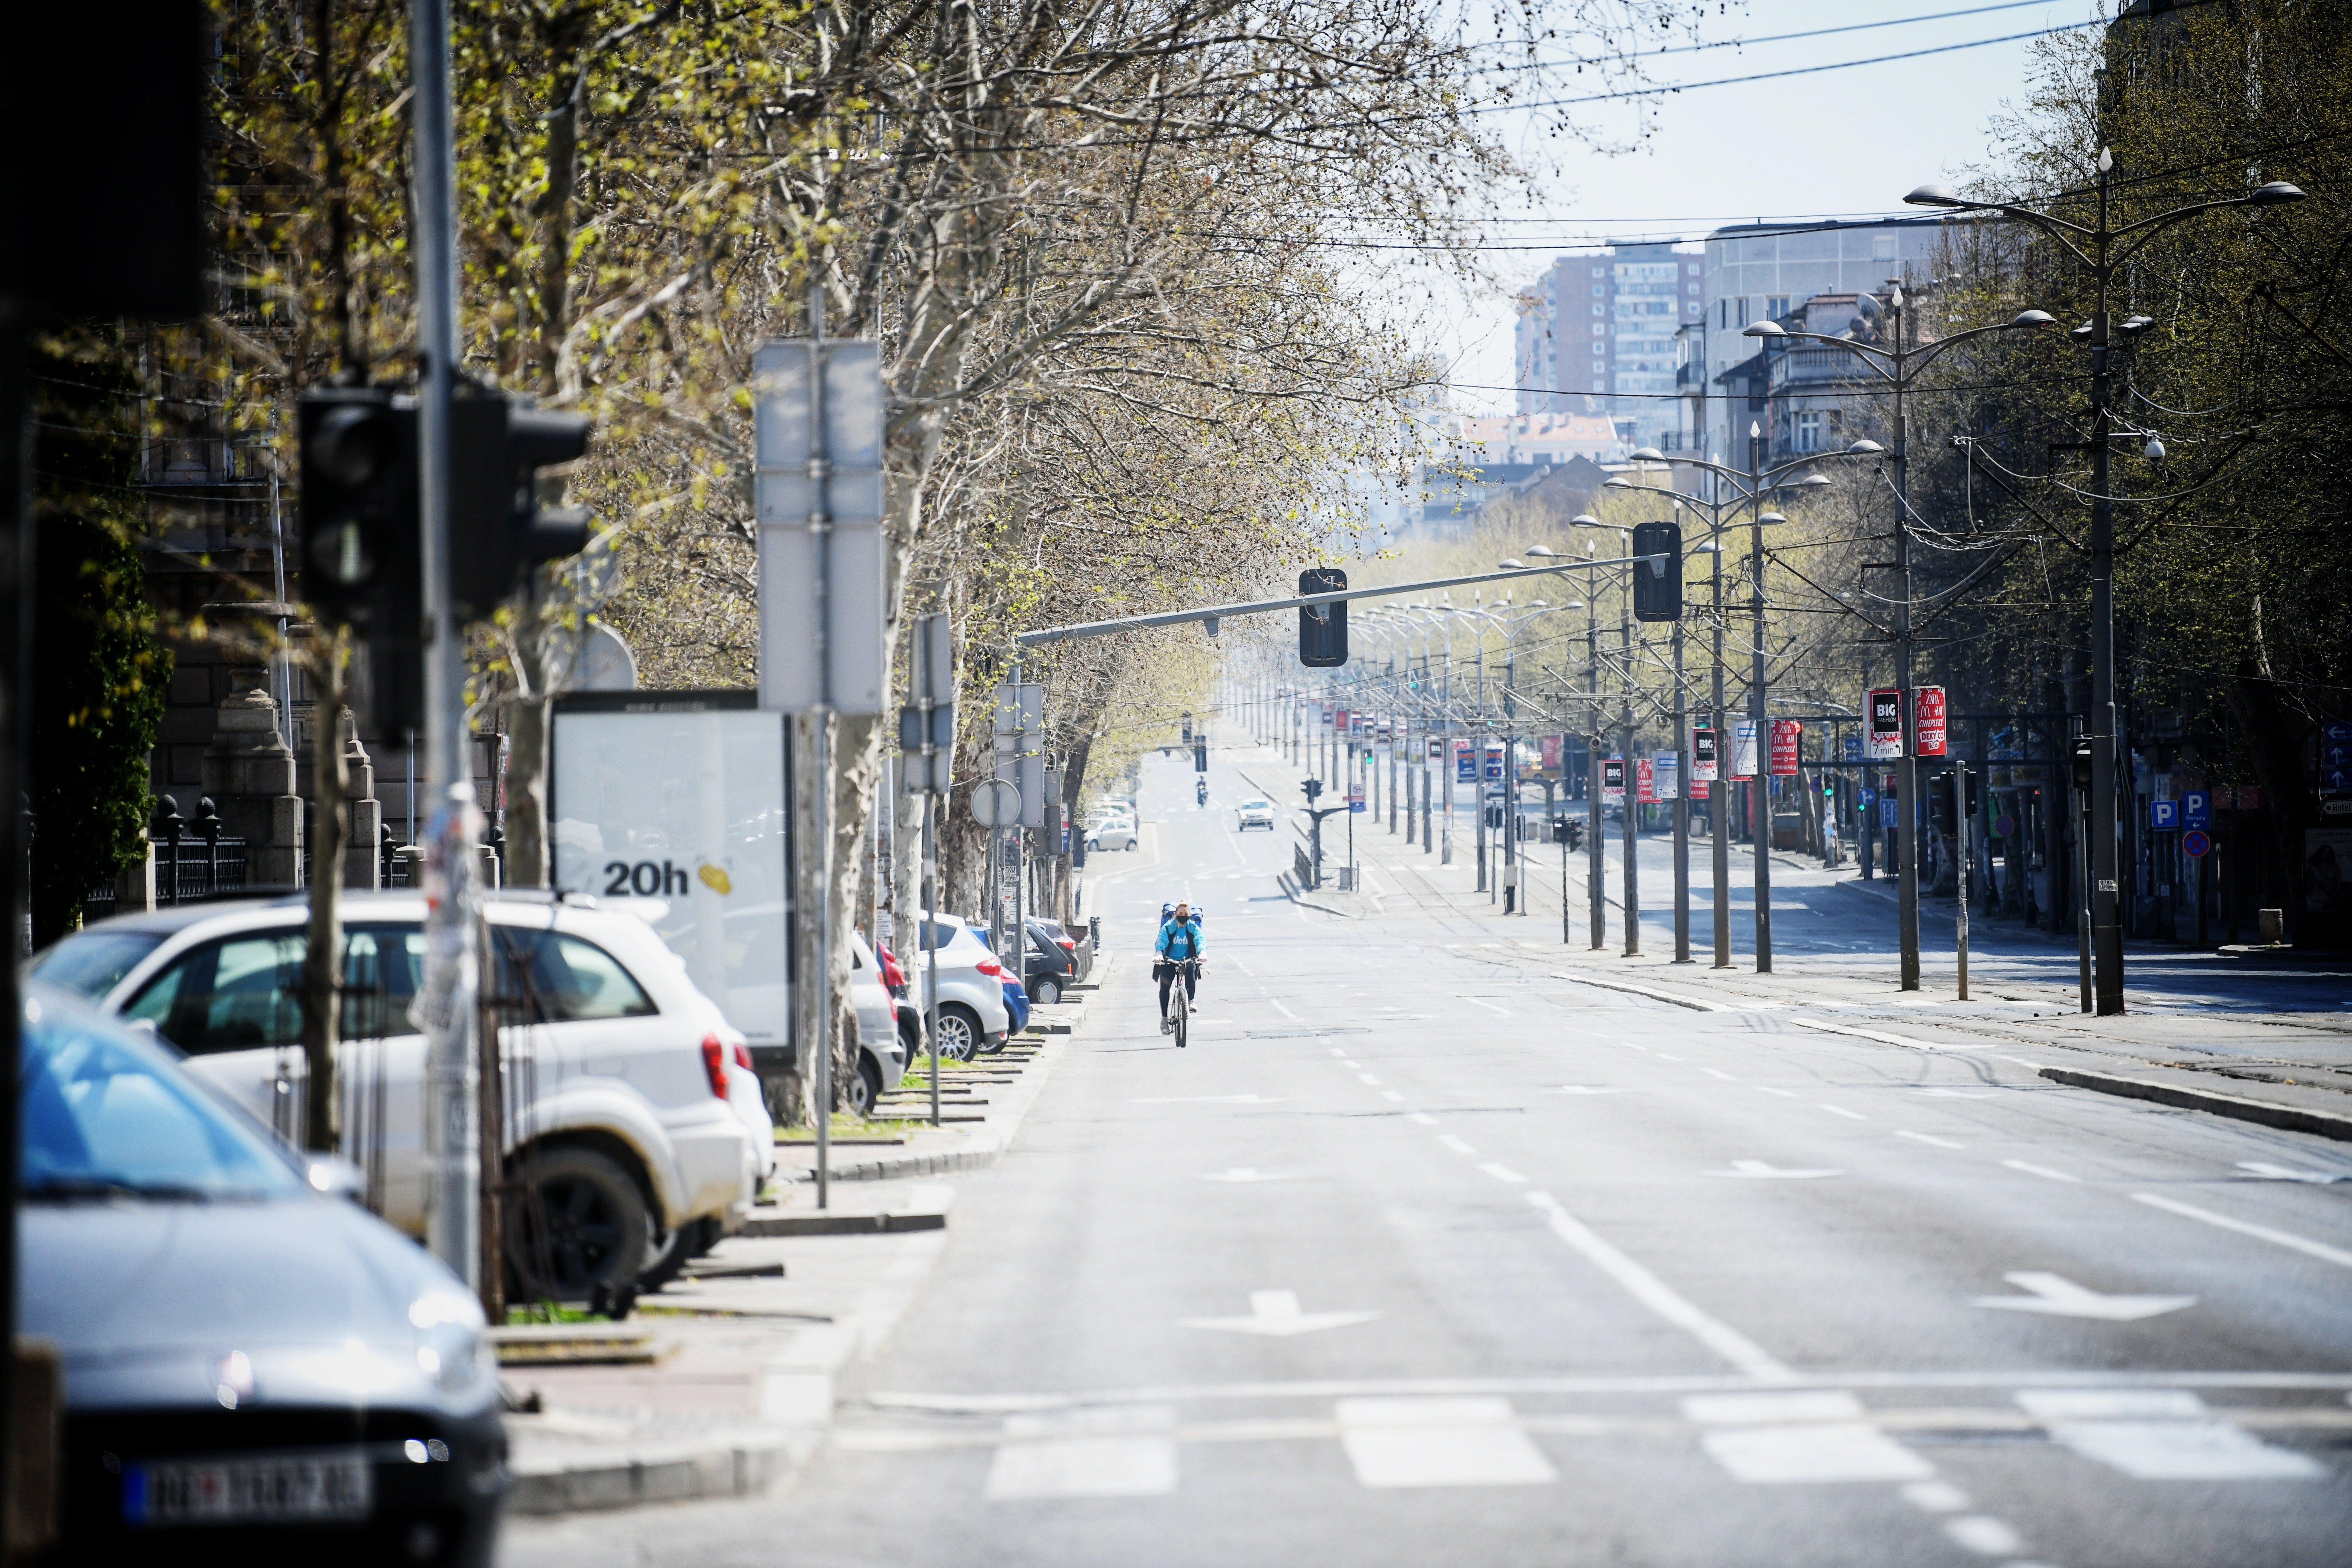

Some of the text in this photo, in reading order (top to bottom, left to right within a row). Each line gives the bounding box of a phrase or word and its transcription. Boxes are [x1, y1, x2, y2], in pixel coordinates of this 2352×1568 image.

[1926, 694, 1940, 704] ZARA
[1877, 704, 1896, 716] BIG
[1934, 705, 1943, 716] H&M
[1919, 716, 1944, 728] CINEPLEXX
[1779, 725, 1792, 733] ZARA
[1787, 734, 1795, 744] H&M
[1922, 732, 1936, 740] DEXY
[1699, 739, 1713, 749] BIG
[1772, 744, 1796, 753] CINEPLEXX
[1873, 744, 1896, 755] 7 min.
[1607, 768, 1621, 777] BIG
[1739, 763, 1744, 772] 7
[1695, 769, 1700, 778] 7
[2188, 795, 2203, 814] P
[2333, 803, 2350, 812] Hotel
[2157, 804, 2171, 824] P
[604, 859, 688, 896] 20h
